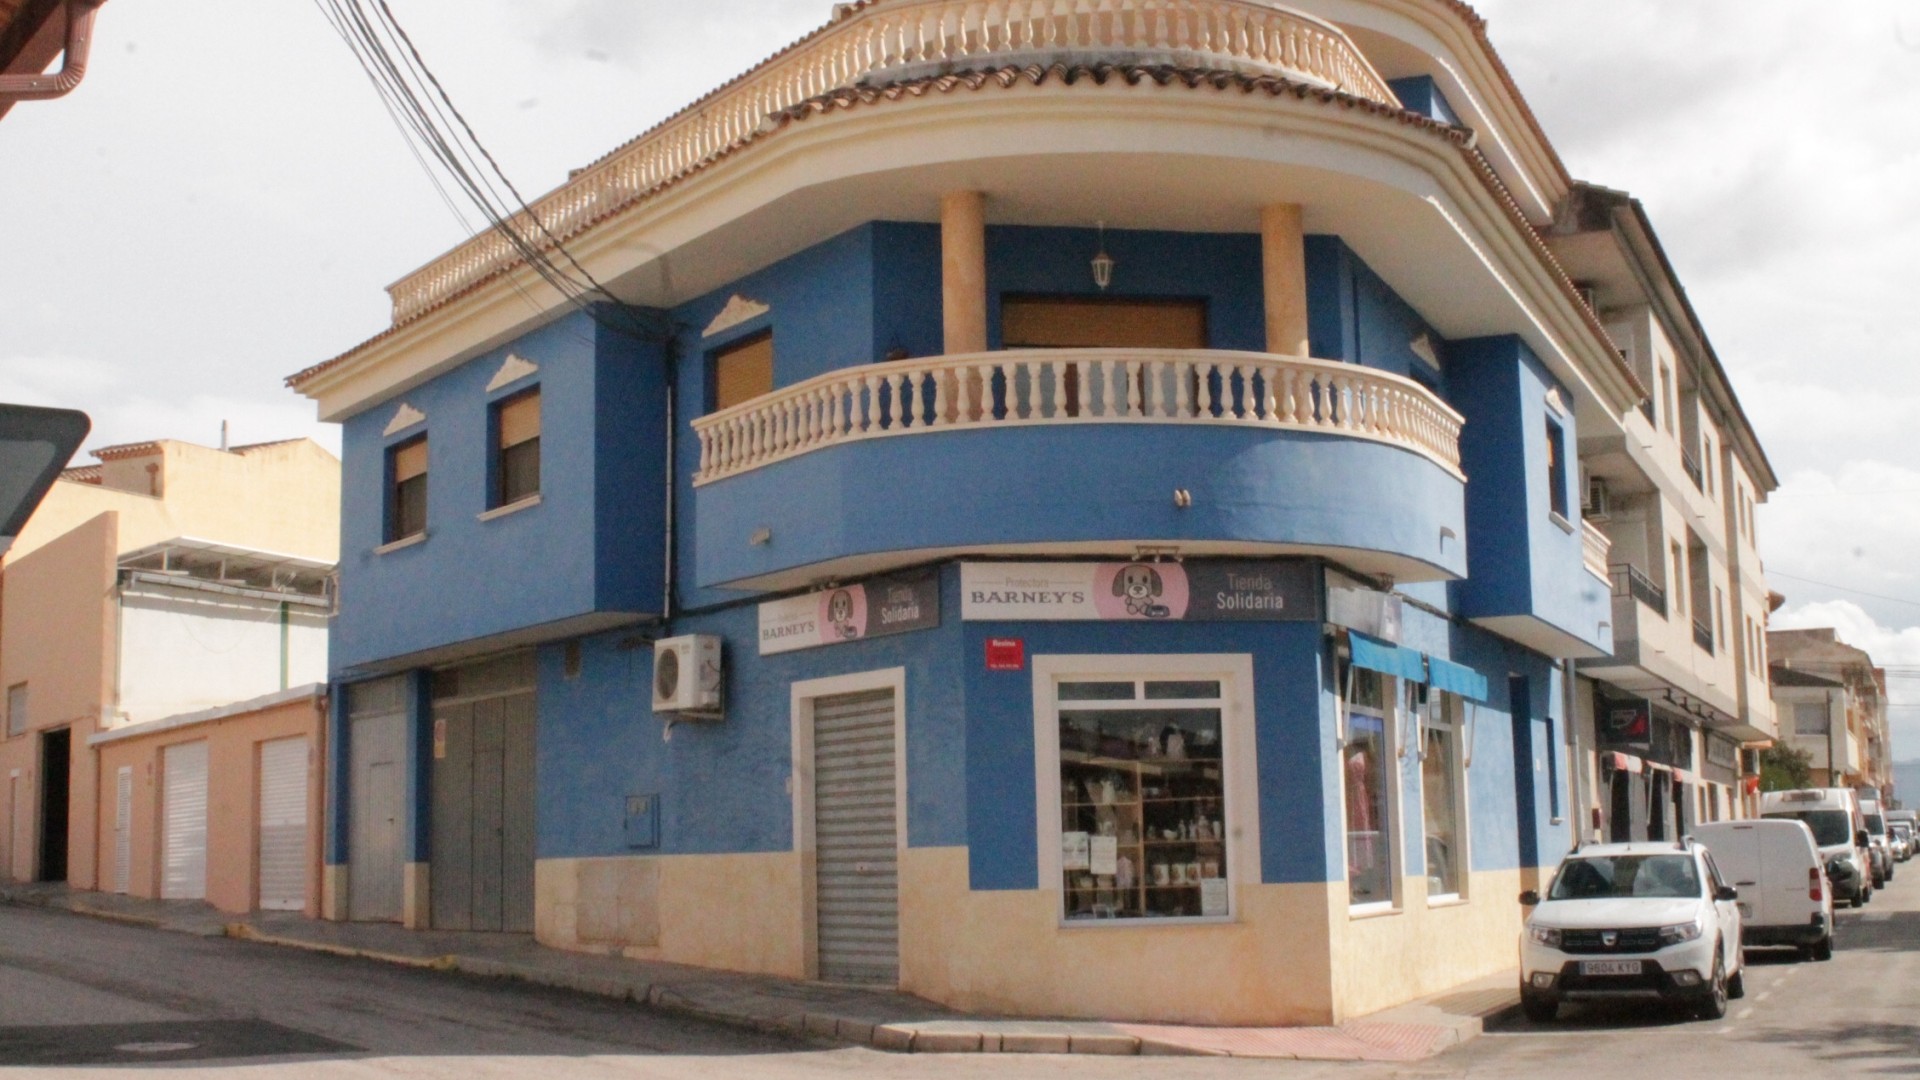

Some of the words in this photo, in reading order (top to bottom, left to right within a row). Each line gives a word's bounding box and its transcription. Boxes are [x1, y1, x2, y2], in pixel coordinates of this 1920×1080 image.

[1226, 573, 1273, 591] Tienda
[971, 591, 1085, 604] BARNEY'S
[1216, 592, 1284, 609] Solidaria
[881, 605, 919, 625] Solidaria
[762, 621, 815, 641] BARNEY'S
